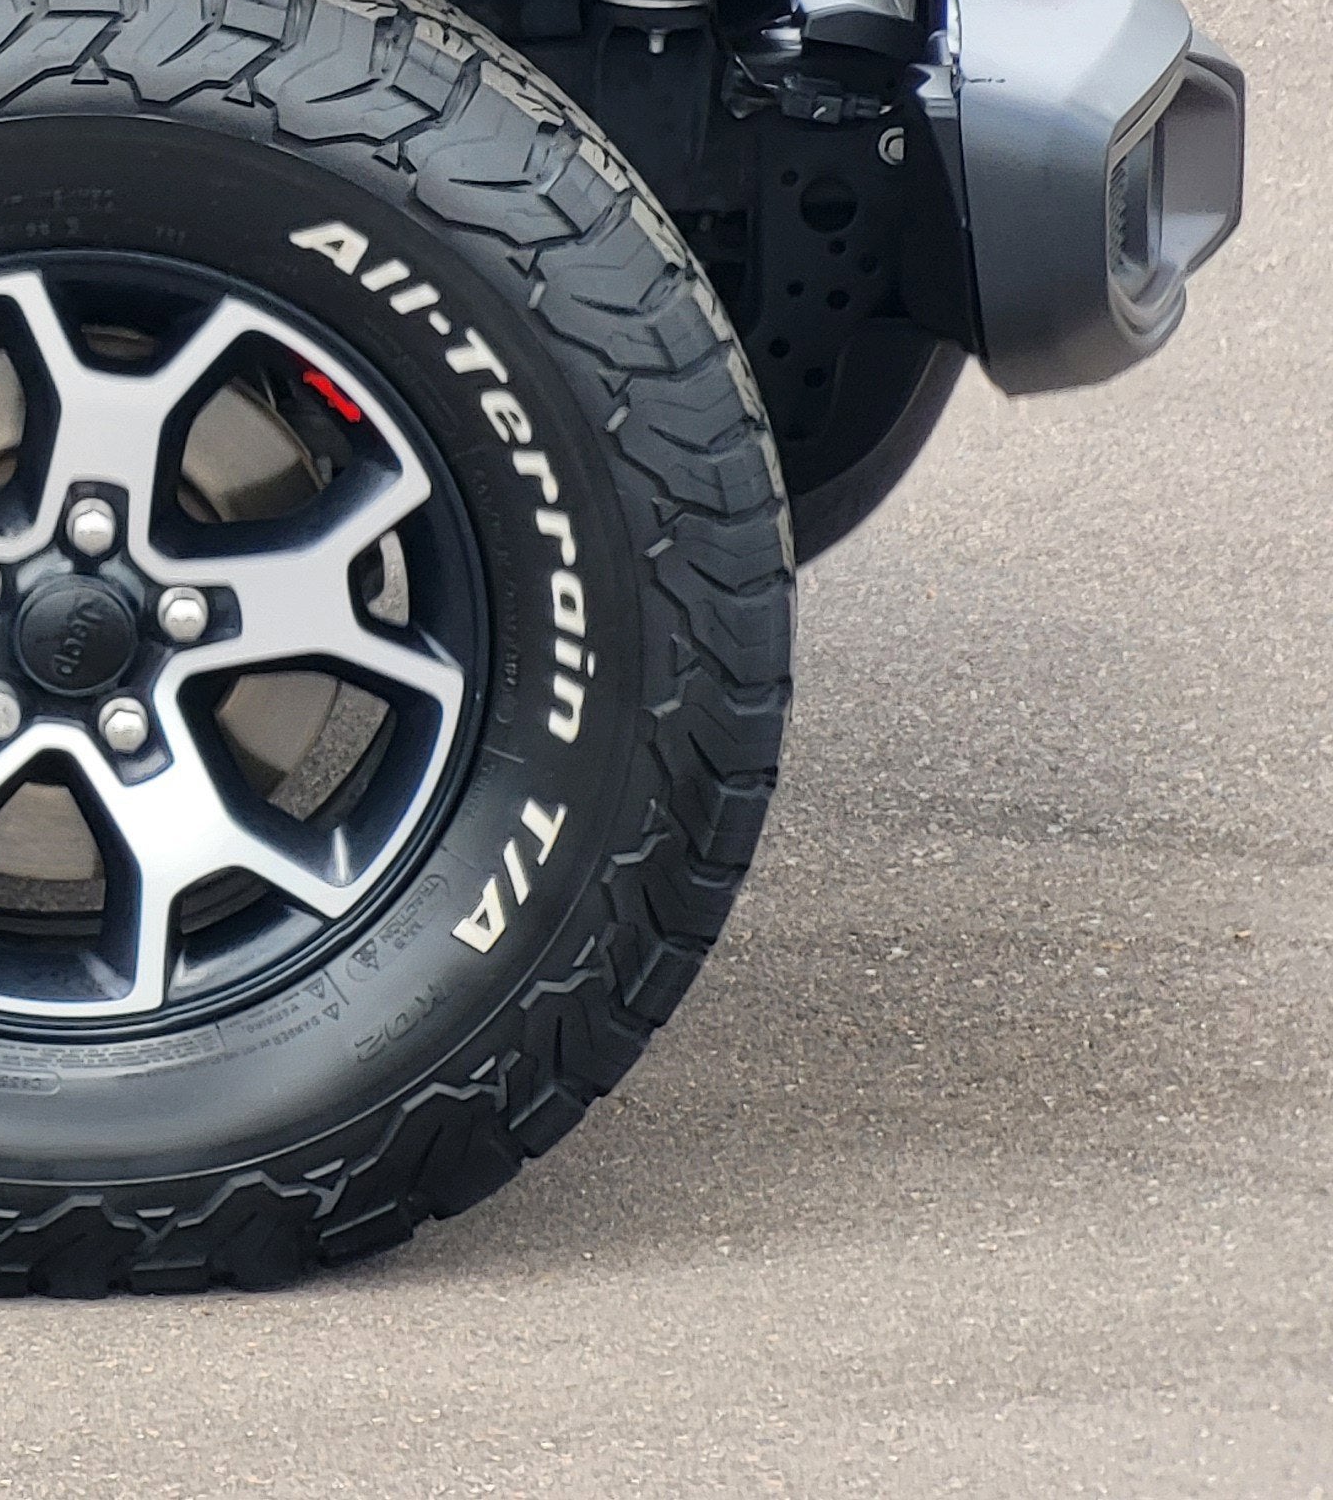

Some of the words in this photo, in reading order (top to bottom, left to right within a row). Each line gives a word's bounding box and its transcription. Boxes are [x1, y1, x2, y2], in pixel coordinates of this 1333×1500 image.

[50, 597, 108, 681] Jeep
[289, 220, 596, 743] All-Terrain
[450, 798, 568, 953] T/A
